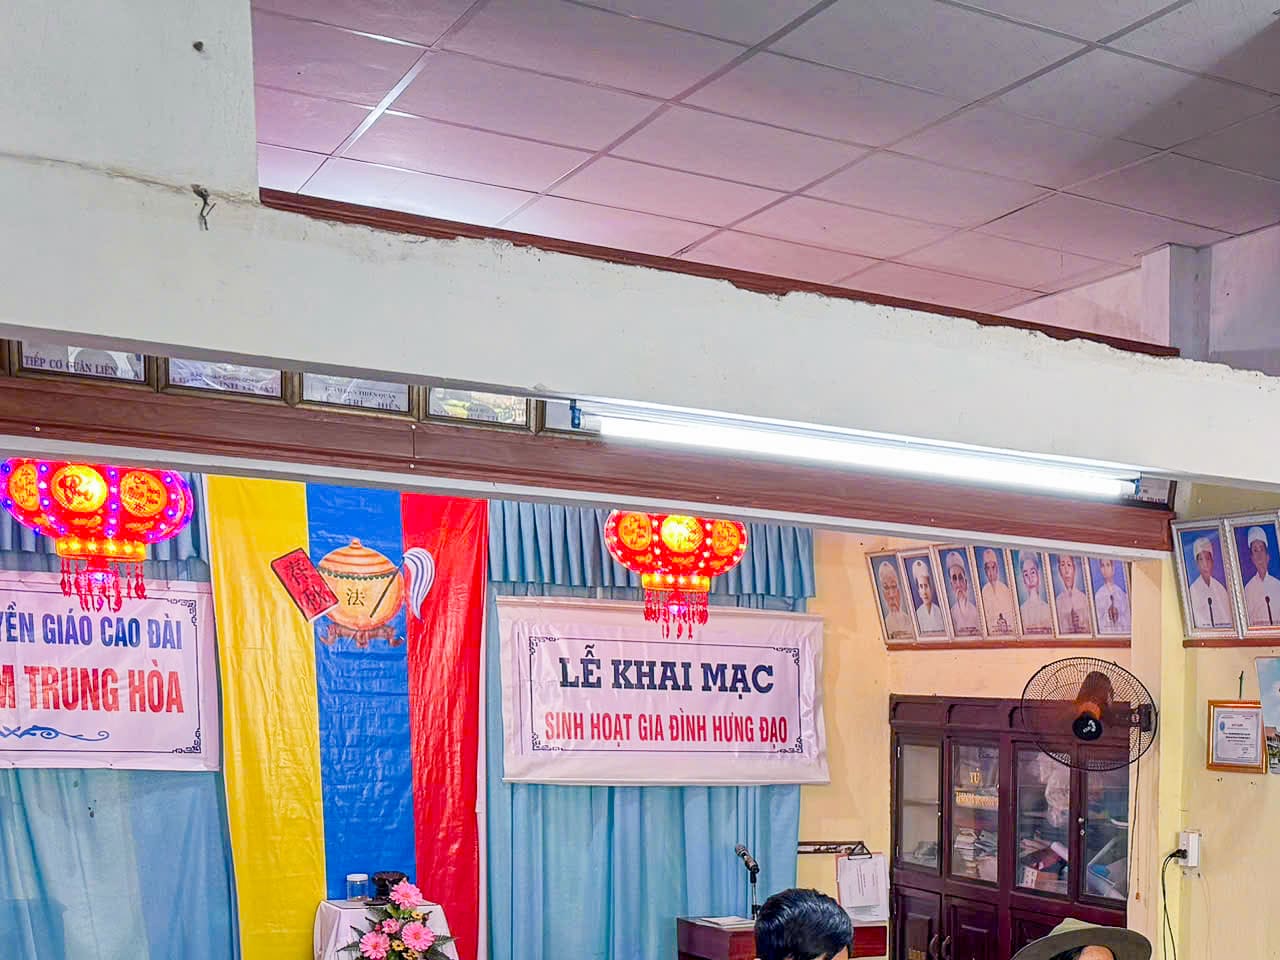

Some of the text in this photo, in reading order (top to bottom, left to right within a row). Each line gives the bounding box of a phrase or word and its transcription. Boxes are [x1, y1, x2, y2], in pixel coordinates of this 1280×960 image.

[42, 608, 93, 646] GIÁO
[101, 616, 140, 647] CAO
[147, 613, 183, 650] ĐÀI
[24, 665, 119, 712] TRUNG
[128, 659, 184, 713] HÒA
[559, 643, 774, 699] LỄ KHAI MẠC
[545, 707, 788, 749] SINH HOẠT GIA ĐÌNH HƯNG ĐẠO
